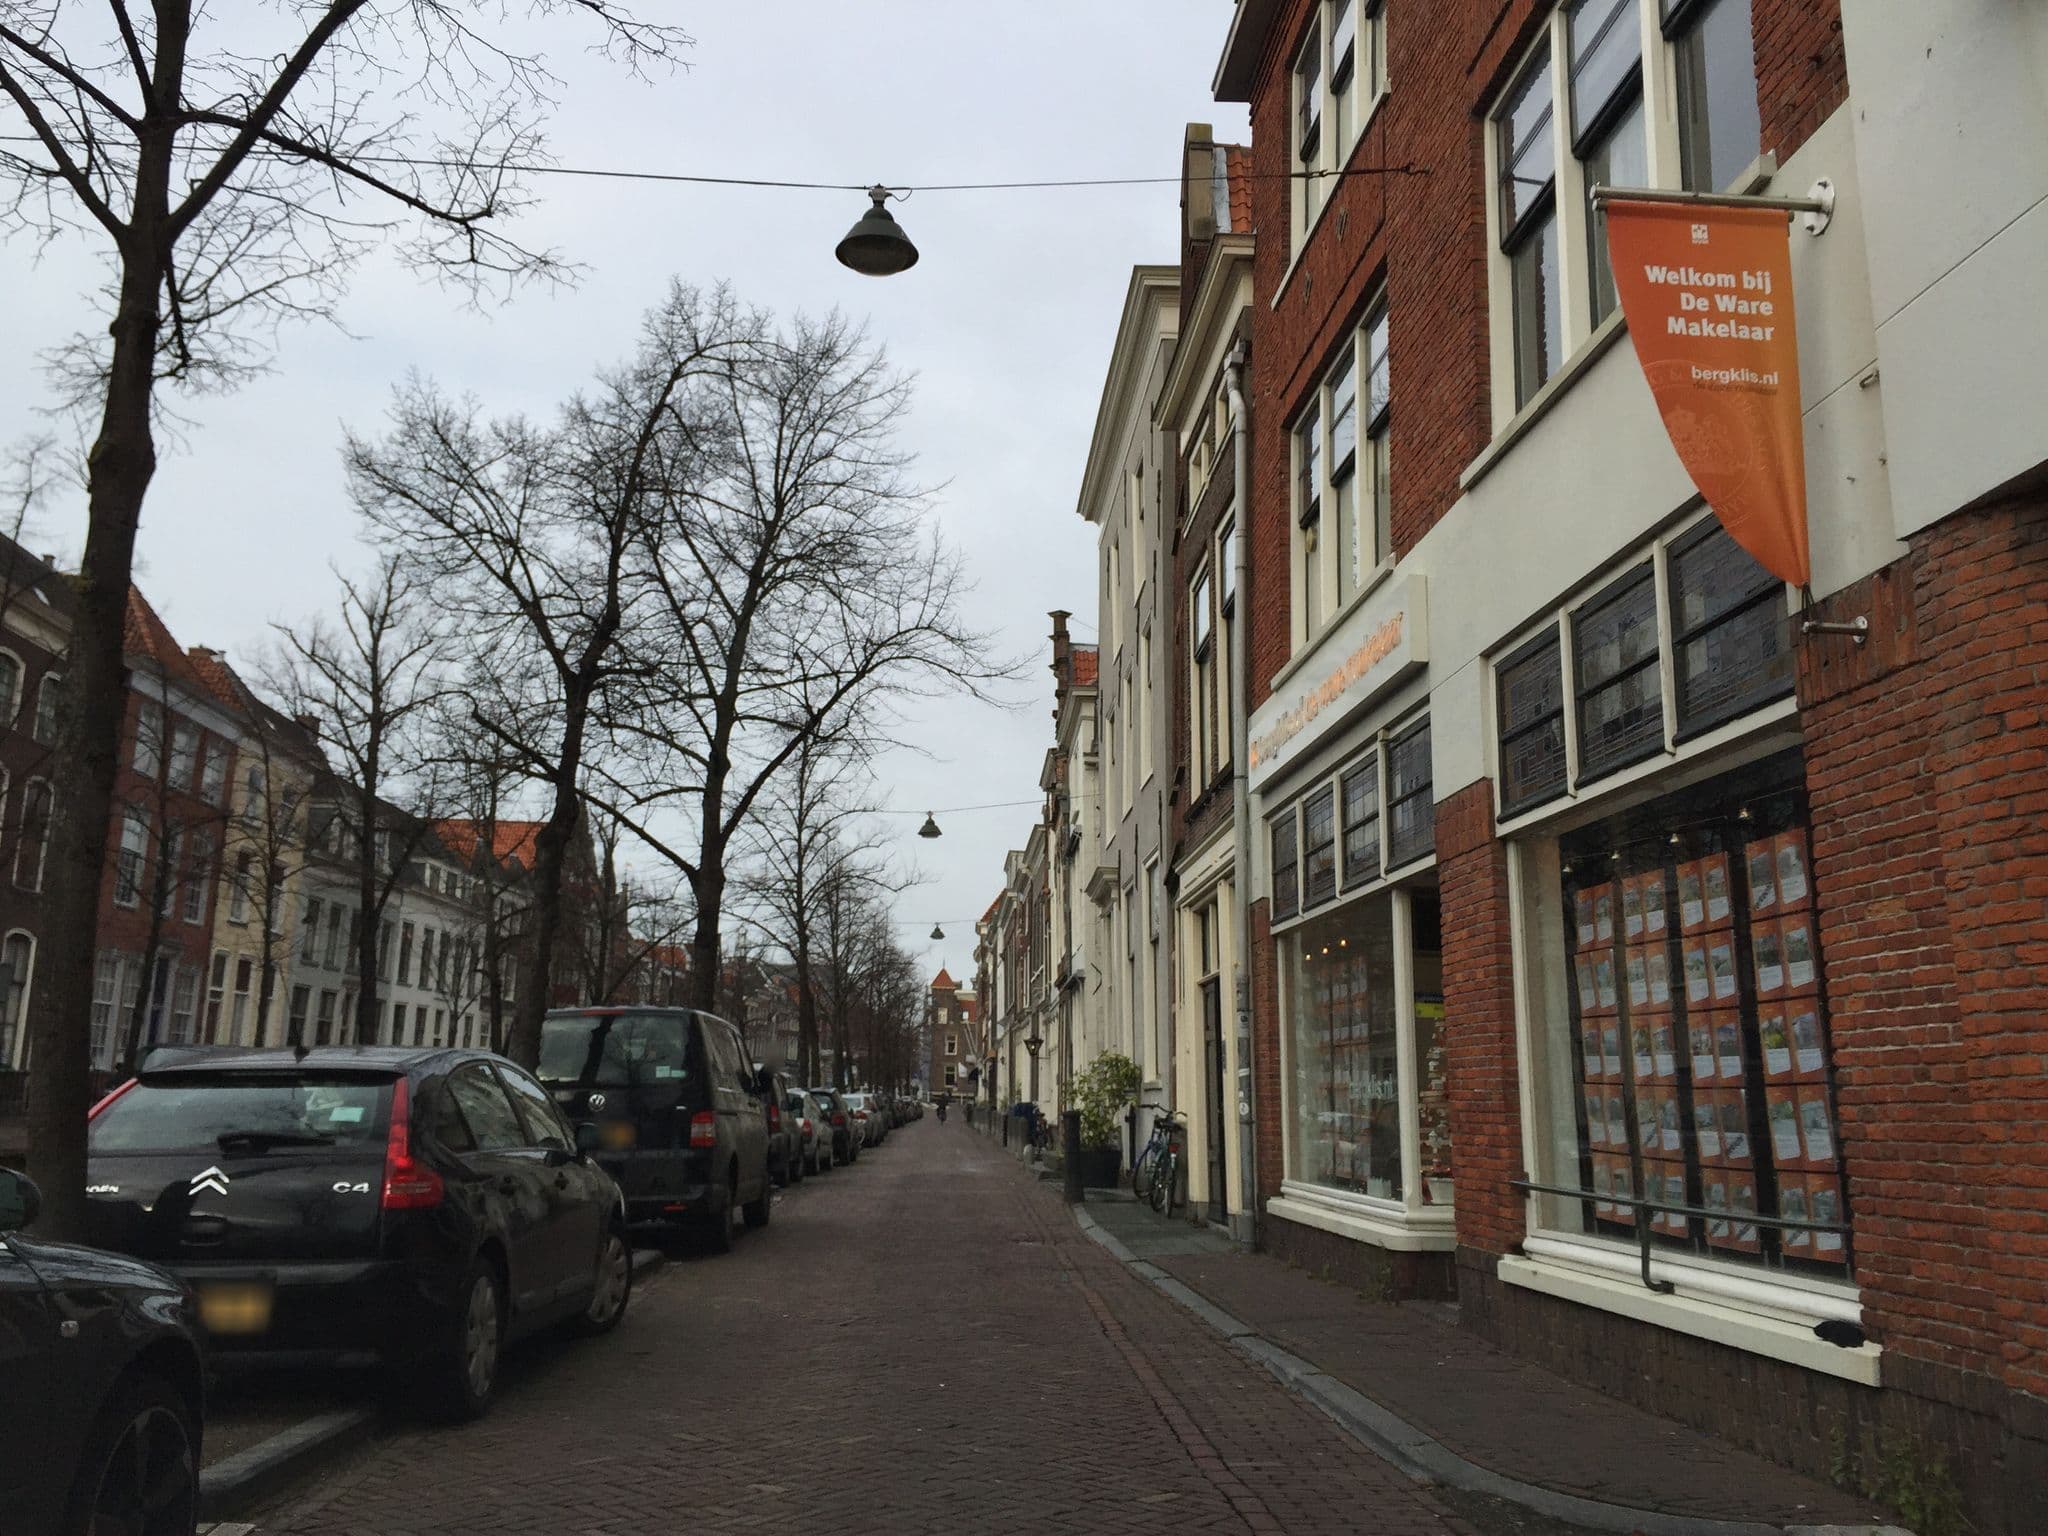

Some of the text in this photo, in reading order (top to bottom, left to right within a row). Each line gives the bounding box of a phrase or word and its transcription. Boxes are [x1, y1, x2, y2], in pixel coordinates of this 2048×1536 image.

[1644, 265, 1772, 295] Welkom bij
[1680, 292, 1774, 316] De Ware
[1667, 316, 1775, 341] Makelaar
[1691, 366, 1779, 385] bergklis.nl
[332, 1181, 370, 1194] C4
